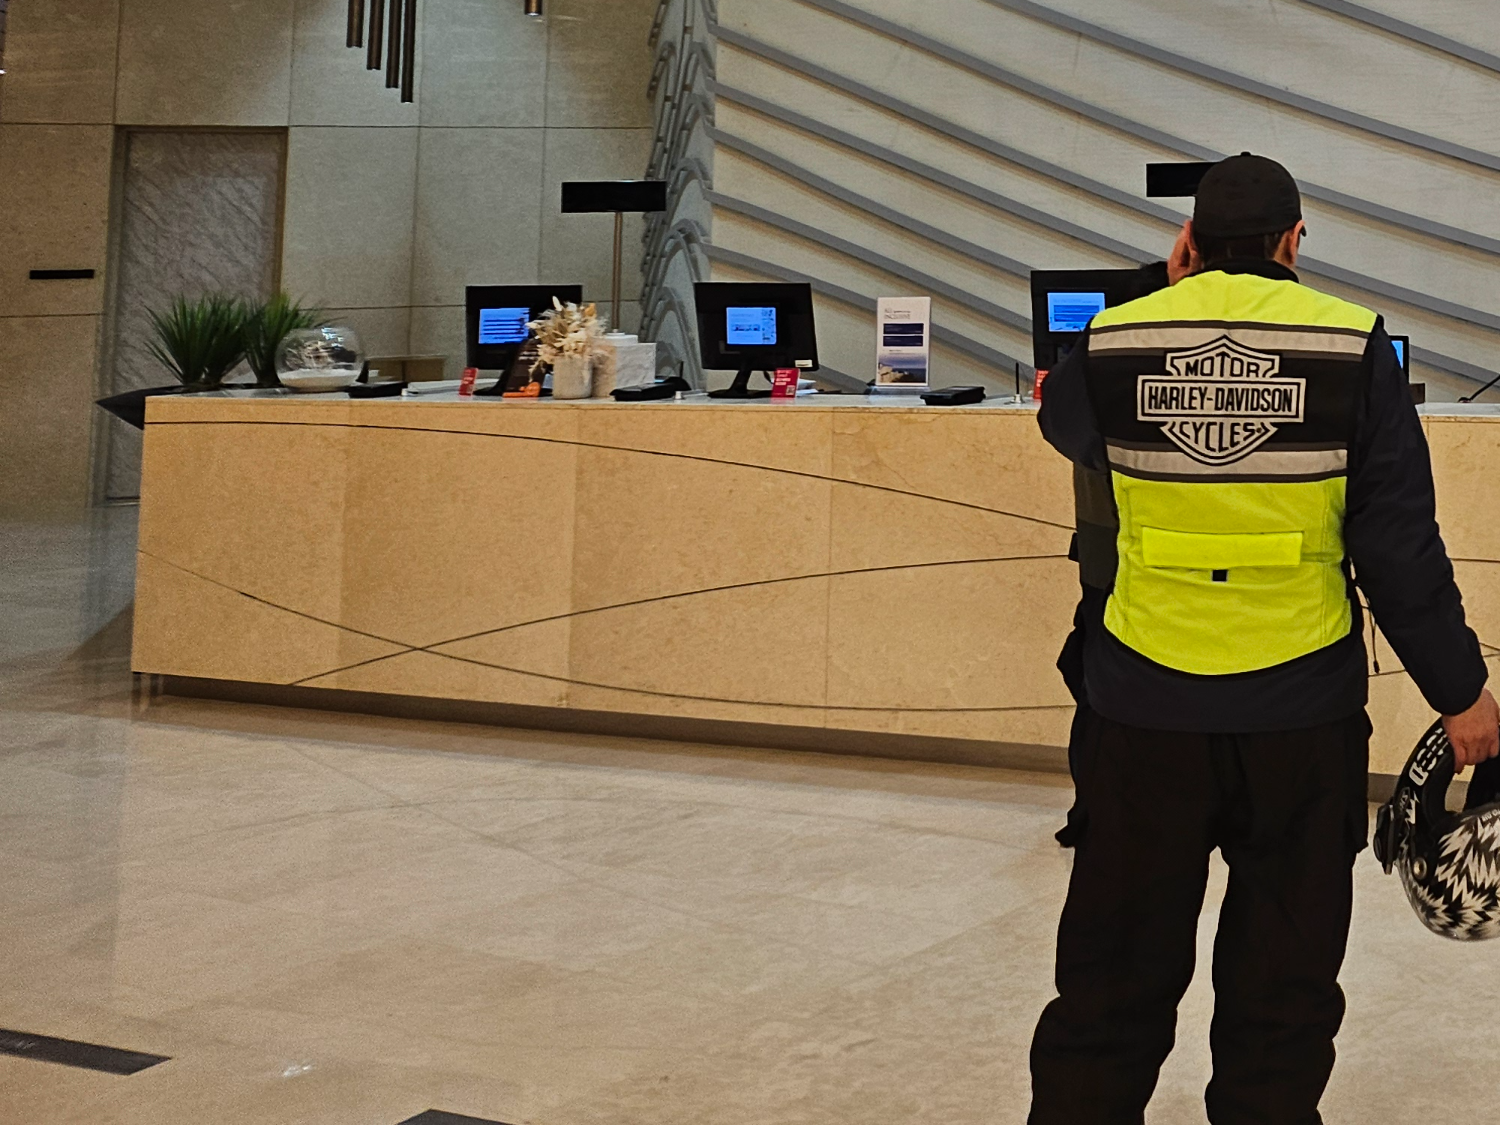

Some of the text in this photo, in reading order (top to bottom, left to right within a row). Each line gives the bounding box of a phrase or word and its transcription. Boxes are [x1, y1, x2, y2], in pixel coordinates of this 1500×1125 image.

[1185, 351, 1260, 378] MOTOR
[1148, 385, 1293, 412] HARLEY-DAVIDSON
[1179, 421, 1256, 453] CYCLES
